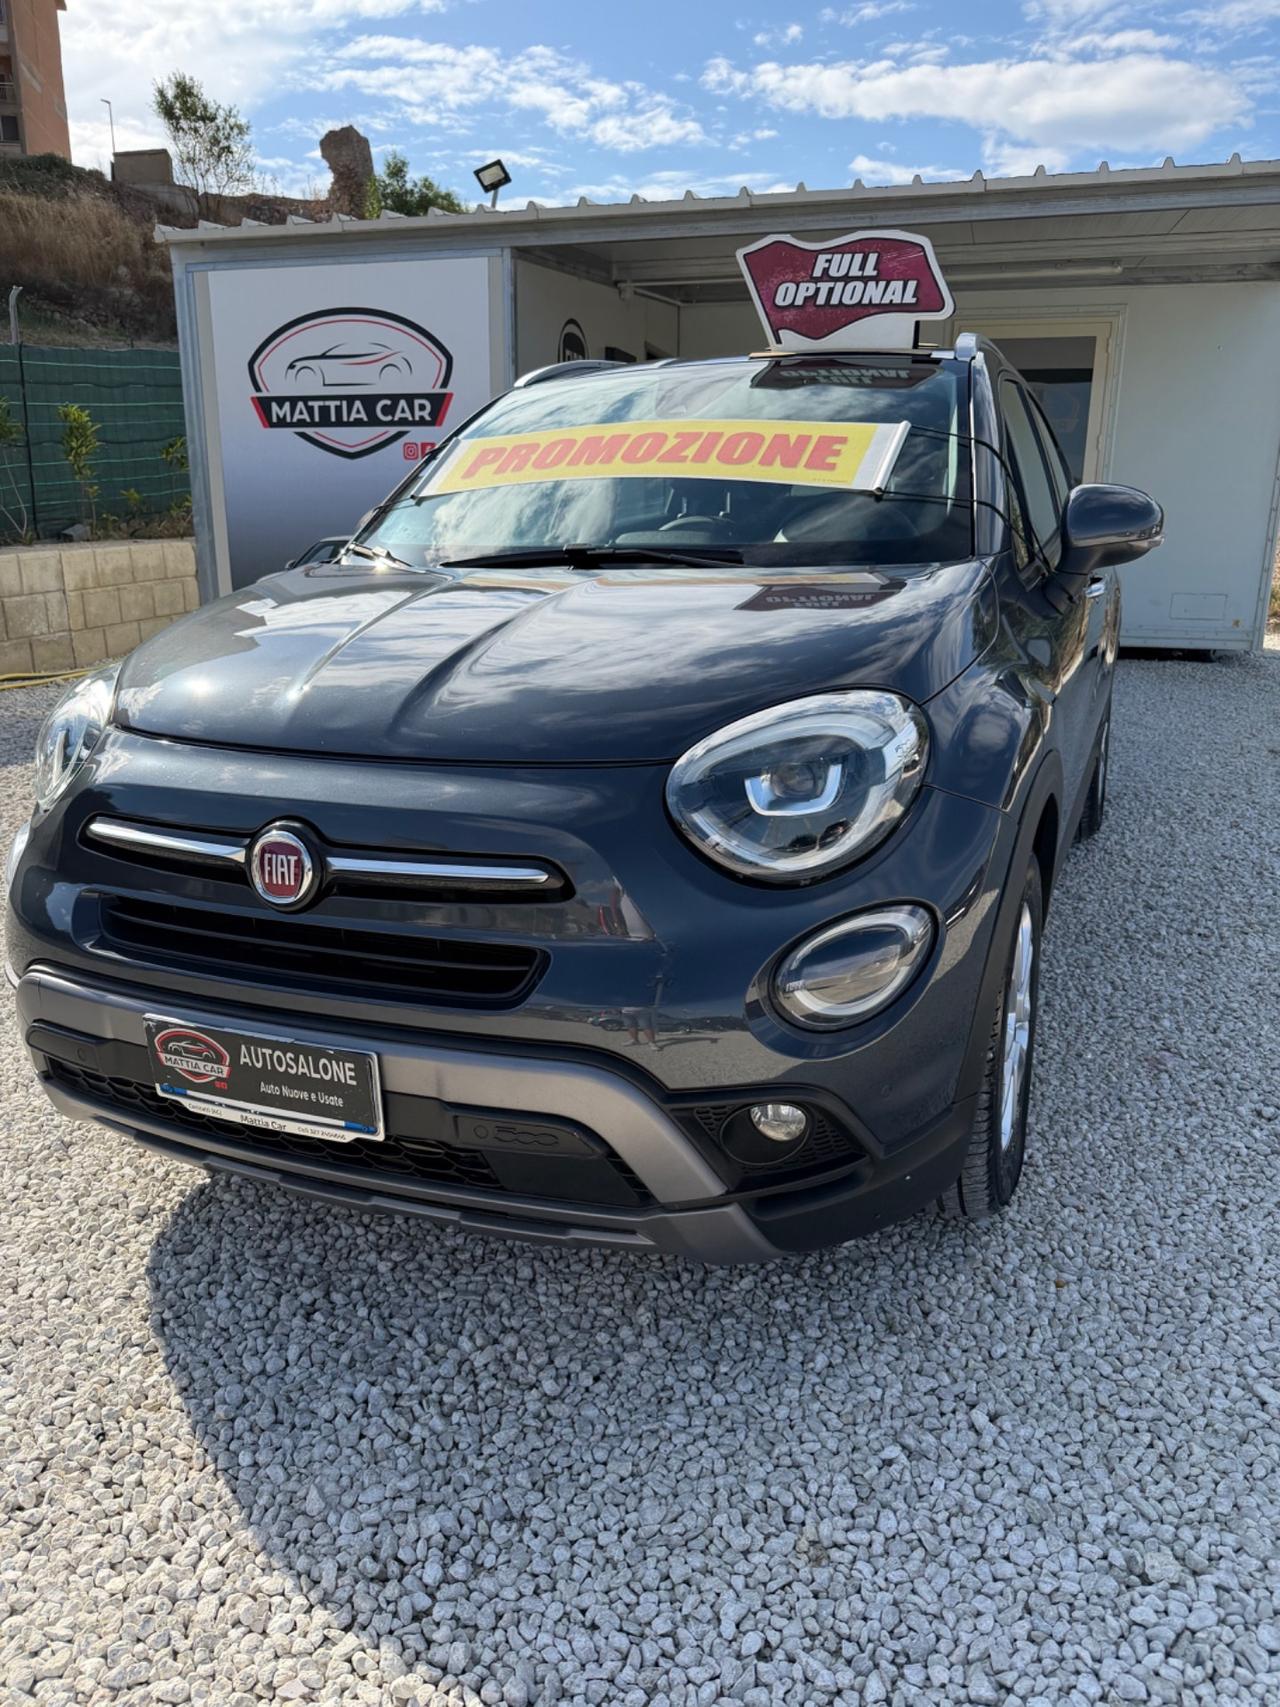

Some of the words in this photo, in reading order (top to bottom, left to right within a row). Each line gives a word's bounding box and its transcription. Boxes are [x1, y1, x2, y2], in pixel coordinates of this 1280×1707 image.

[811, 252, 879, 278] FULL
[774, 280, 918, 306] OPTIONAL
[270, 400, 368, 422] MATTIA
[375, 399, 432, 421] CAR
[460, 431, 849, 479] PROMOZIONE
[263, 853, 298, 886] FIAT
[165, 1056, 201, 1071] MATTIA
[203, 1064, 224, 1075] CAR
[240, 1044, 357, 1086] AUTOSALONE
[260, 1081, 280, 1095] Auto
[281, 1085, 309, 1101] Nuove
[310, 1093, 317, 1101] e
[318, 1092, 344, 1107] Usate
[240, 1114, 270, 1127] Mattia
[271, 1121, 287, 1131] Car
